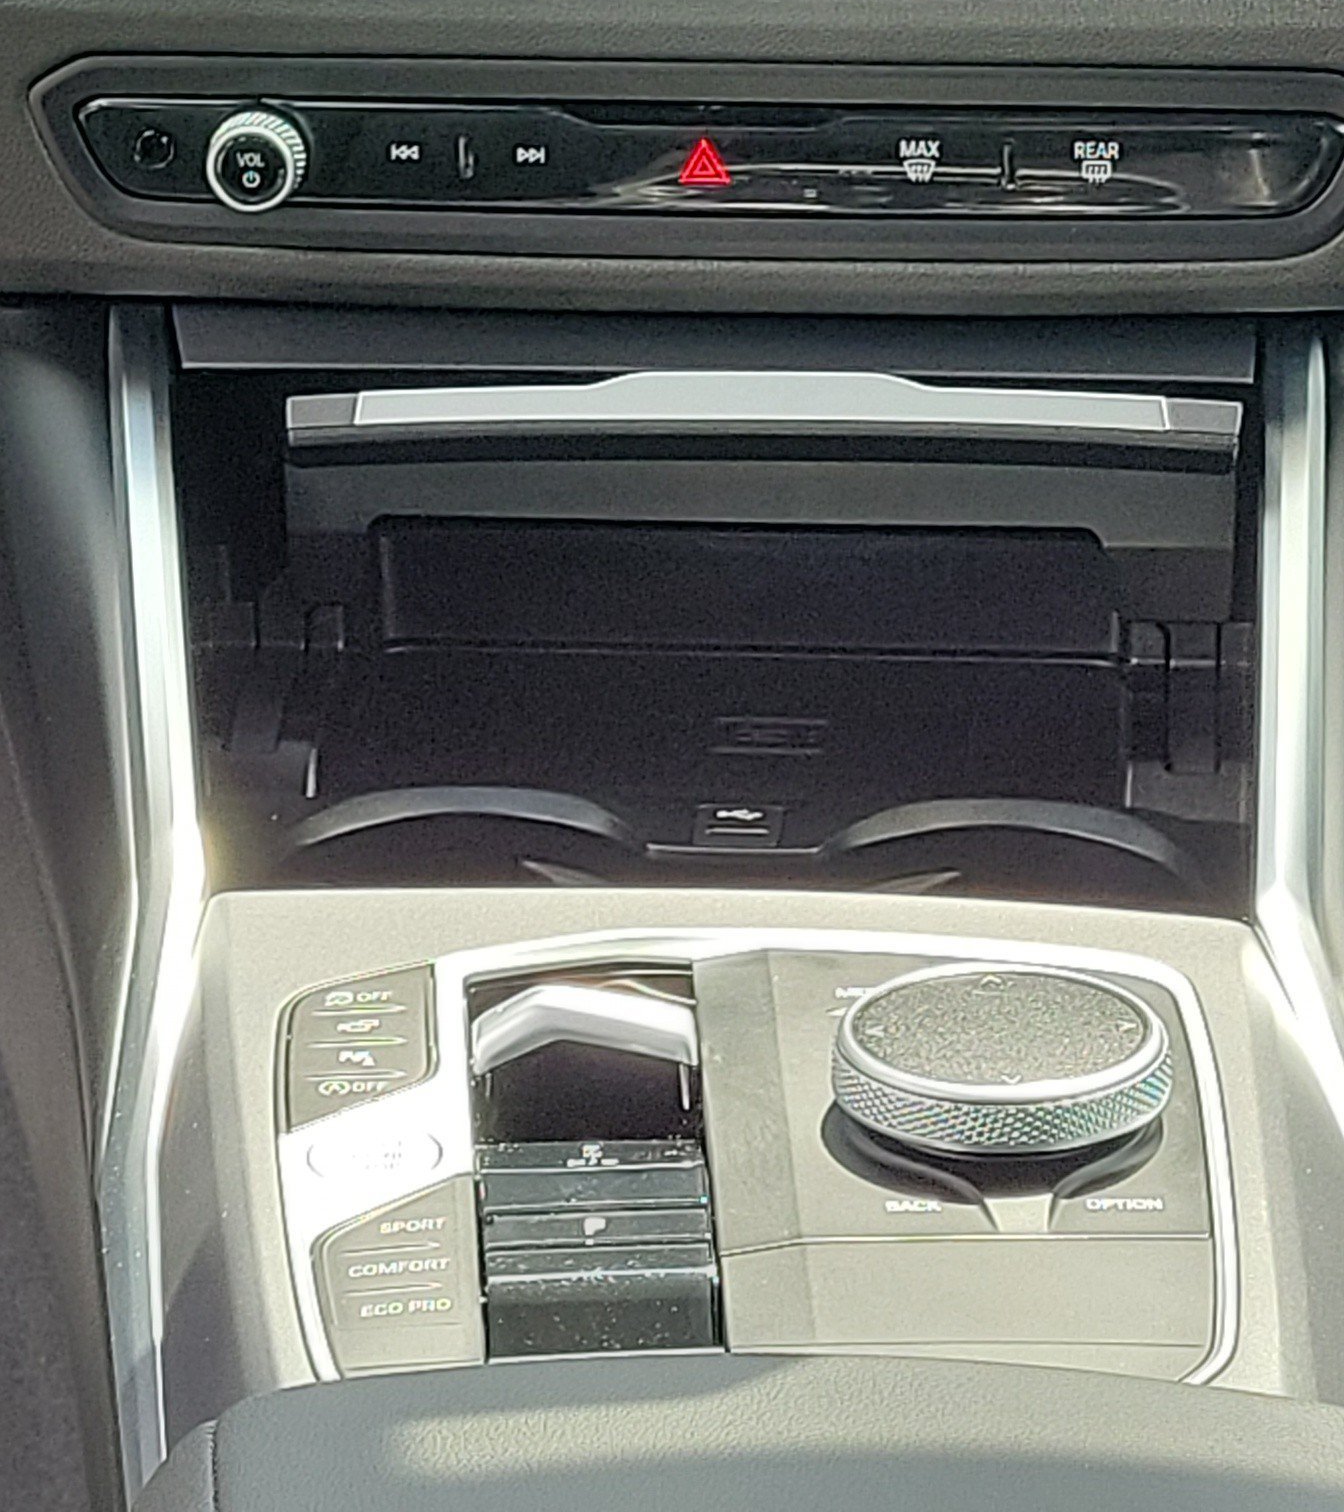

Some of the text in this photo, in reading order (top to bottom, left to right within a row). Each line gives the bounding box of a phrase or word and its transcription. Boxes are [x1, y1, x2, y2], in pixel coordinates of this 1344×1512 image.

[899, 139, 940, 158] MAX
[1073, 141, 1120, 160] REAR
[236, 151, 265, 168] VOL
[885, 1199, 942, 1213] BACK
[1085, 1197, 1164, 1211] OPTION
[379, 1216, 447, 1234] SPORT
[348, 1257, 451, 1278] COMFORT
[359, 1297, 452, 1318] ECO PRO
